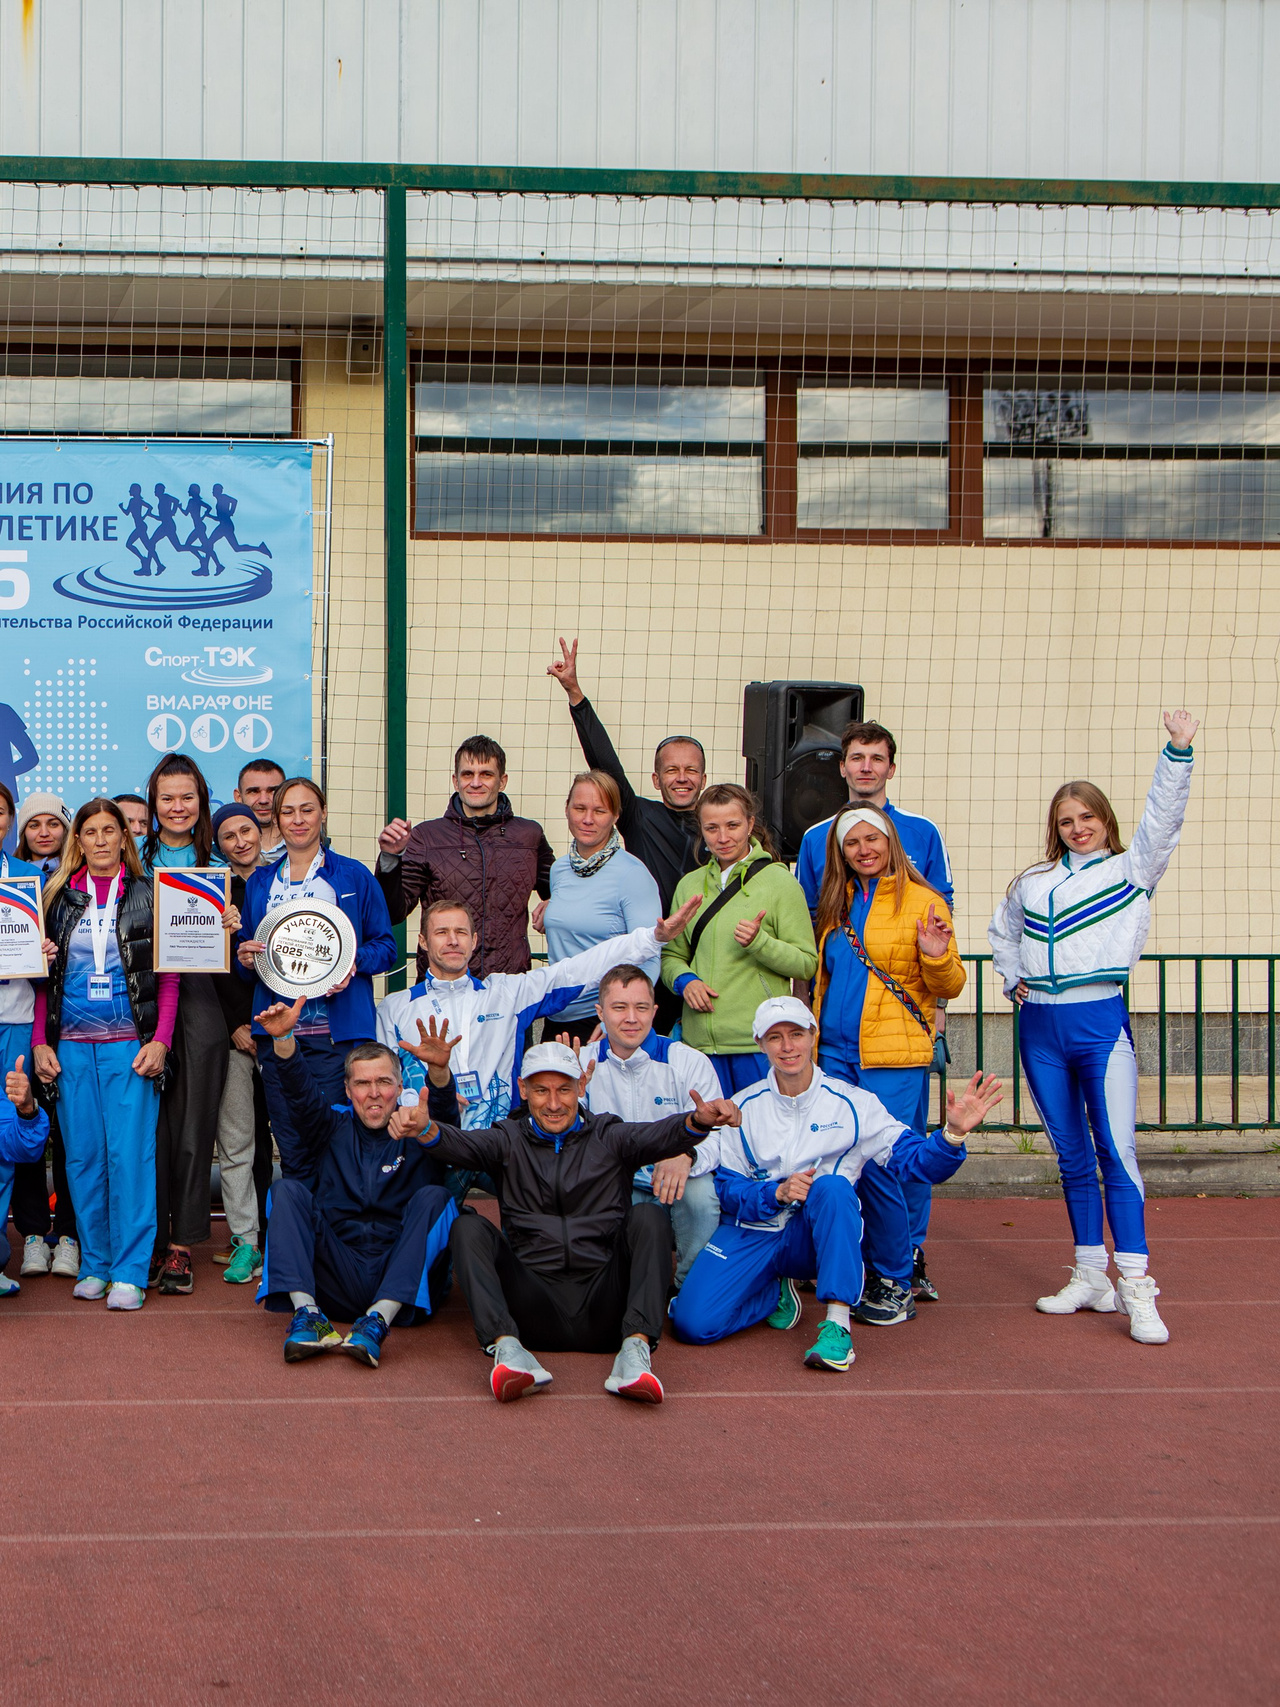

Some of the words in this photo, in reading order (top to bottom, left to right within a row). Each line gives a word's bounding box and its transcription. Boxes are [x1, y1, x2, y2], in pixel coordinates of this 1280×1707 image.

[53, 482, 94, 505] ПО
[78, 614, 173, 629] Российской
[178, 614, 273, 632] Федерации
[146, 694, 273, 711] ВМАРАФОНЕ
[170, 915, 215, 927] ДИПЛОМ
[284, 917, 336, 942] УЧАСТНИК
[275, 944, 303, 957] 2025
